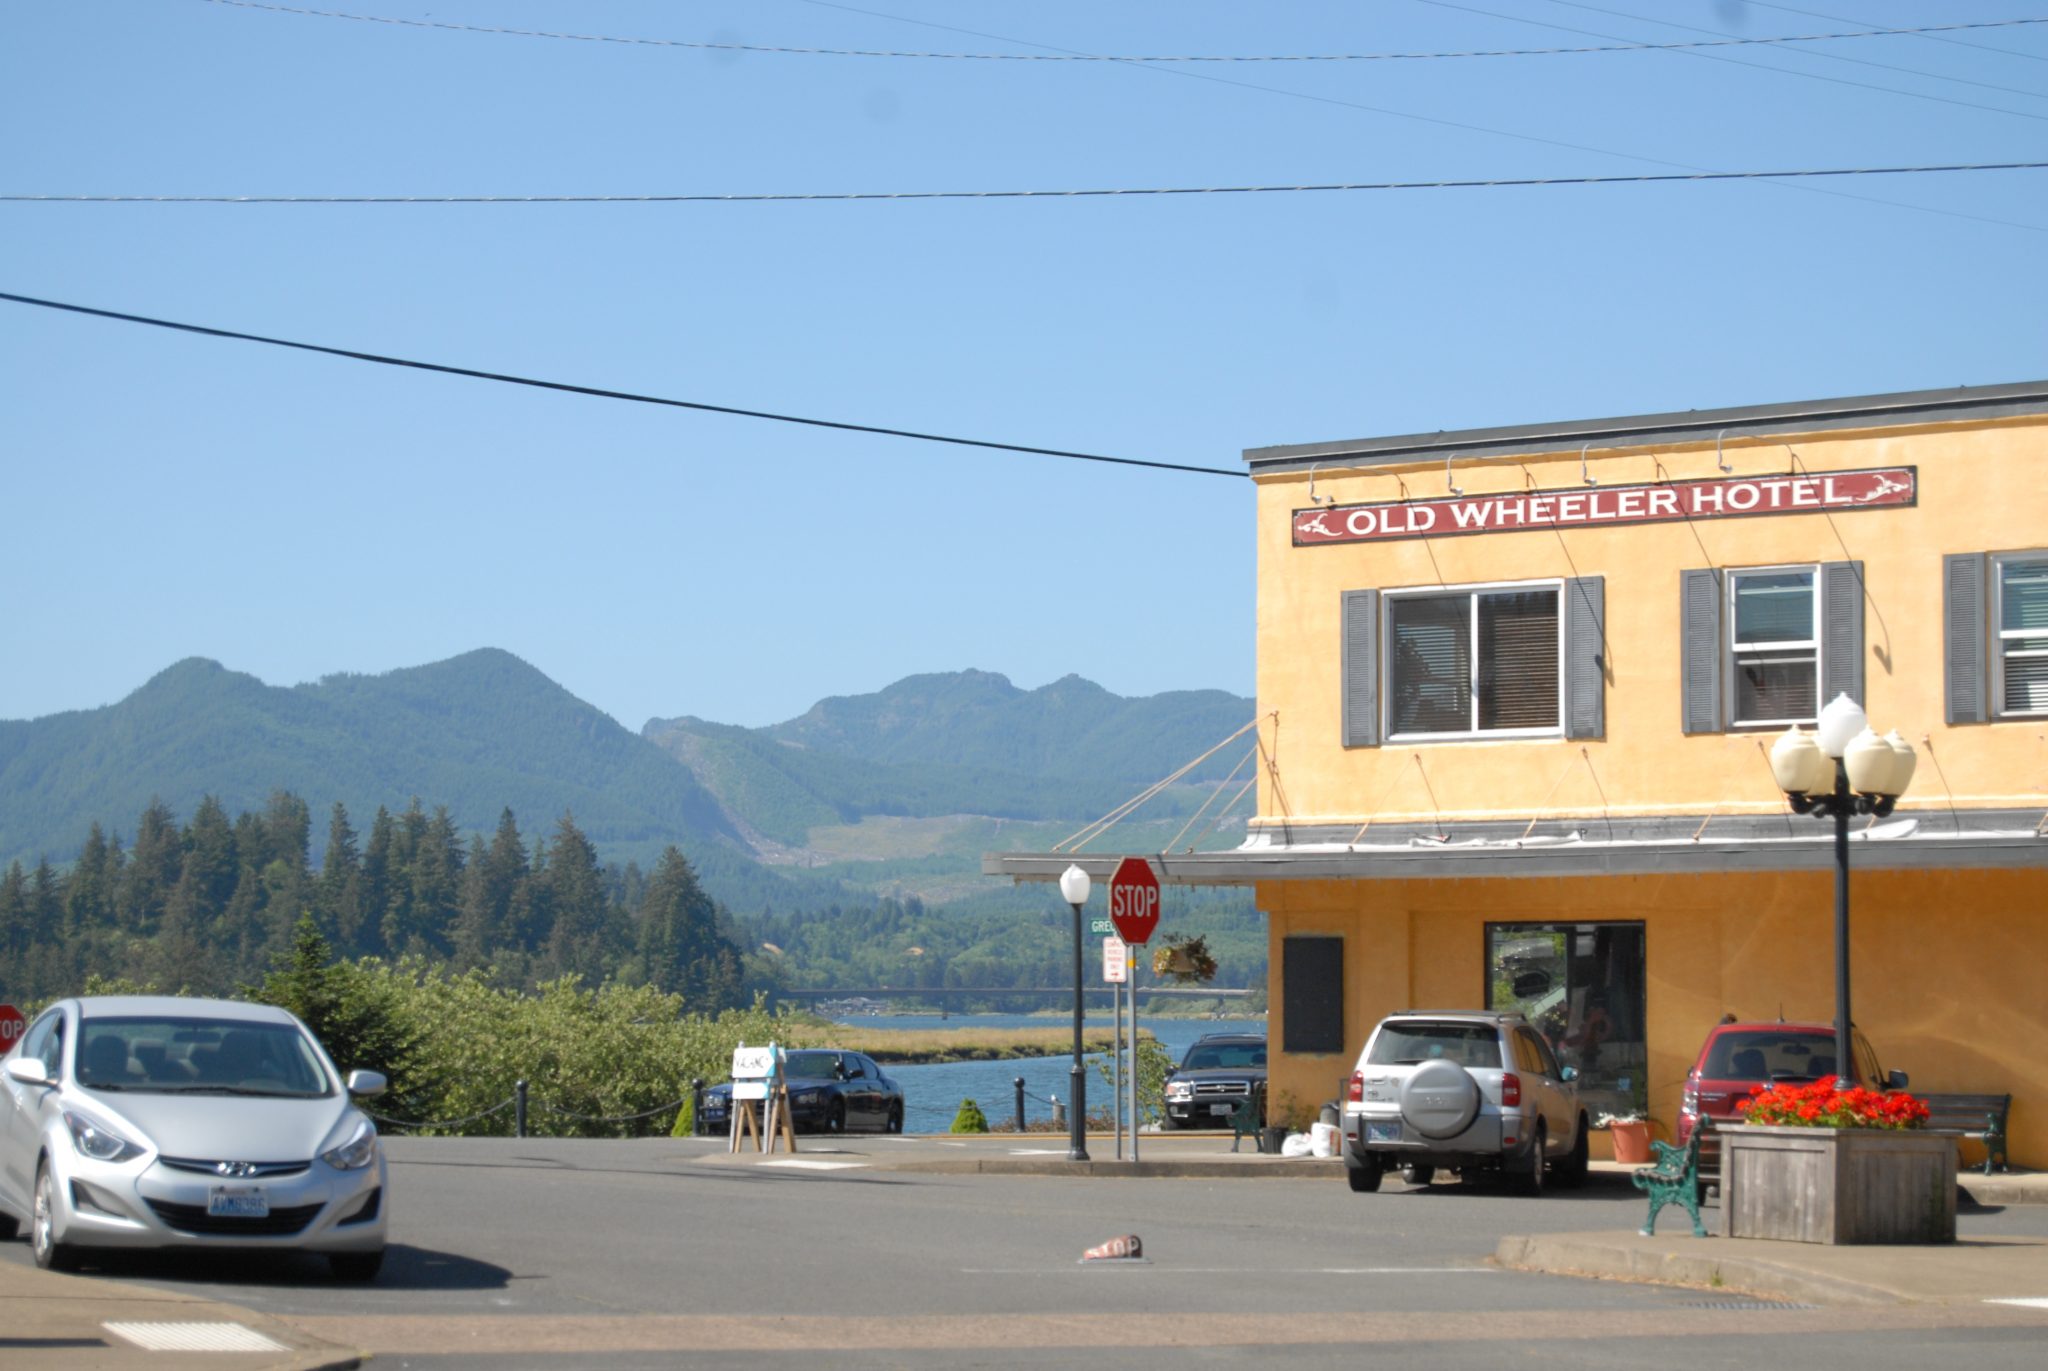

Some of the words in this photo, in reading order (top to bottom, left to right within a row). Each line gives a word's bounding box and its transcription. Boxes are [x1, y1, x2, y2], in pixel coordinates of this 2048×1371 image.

[1346, 506, 1436, 535] OLD
[1449, 490, 1678, 528] WHEELER
[1692, 478, 1853, 513] HOTEL
[1114, 884, 1157, 918] STOP
[0, 1020, 23, 1039] OP
